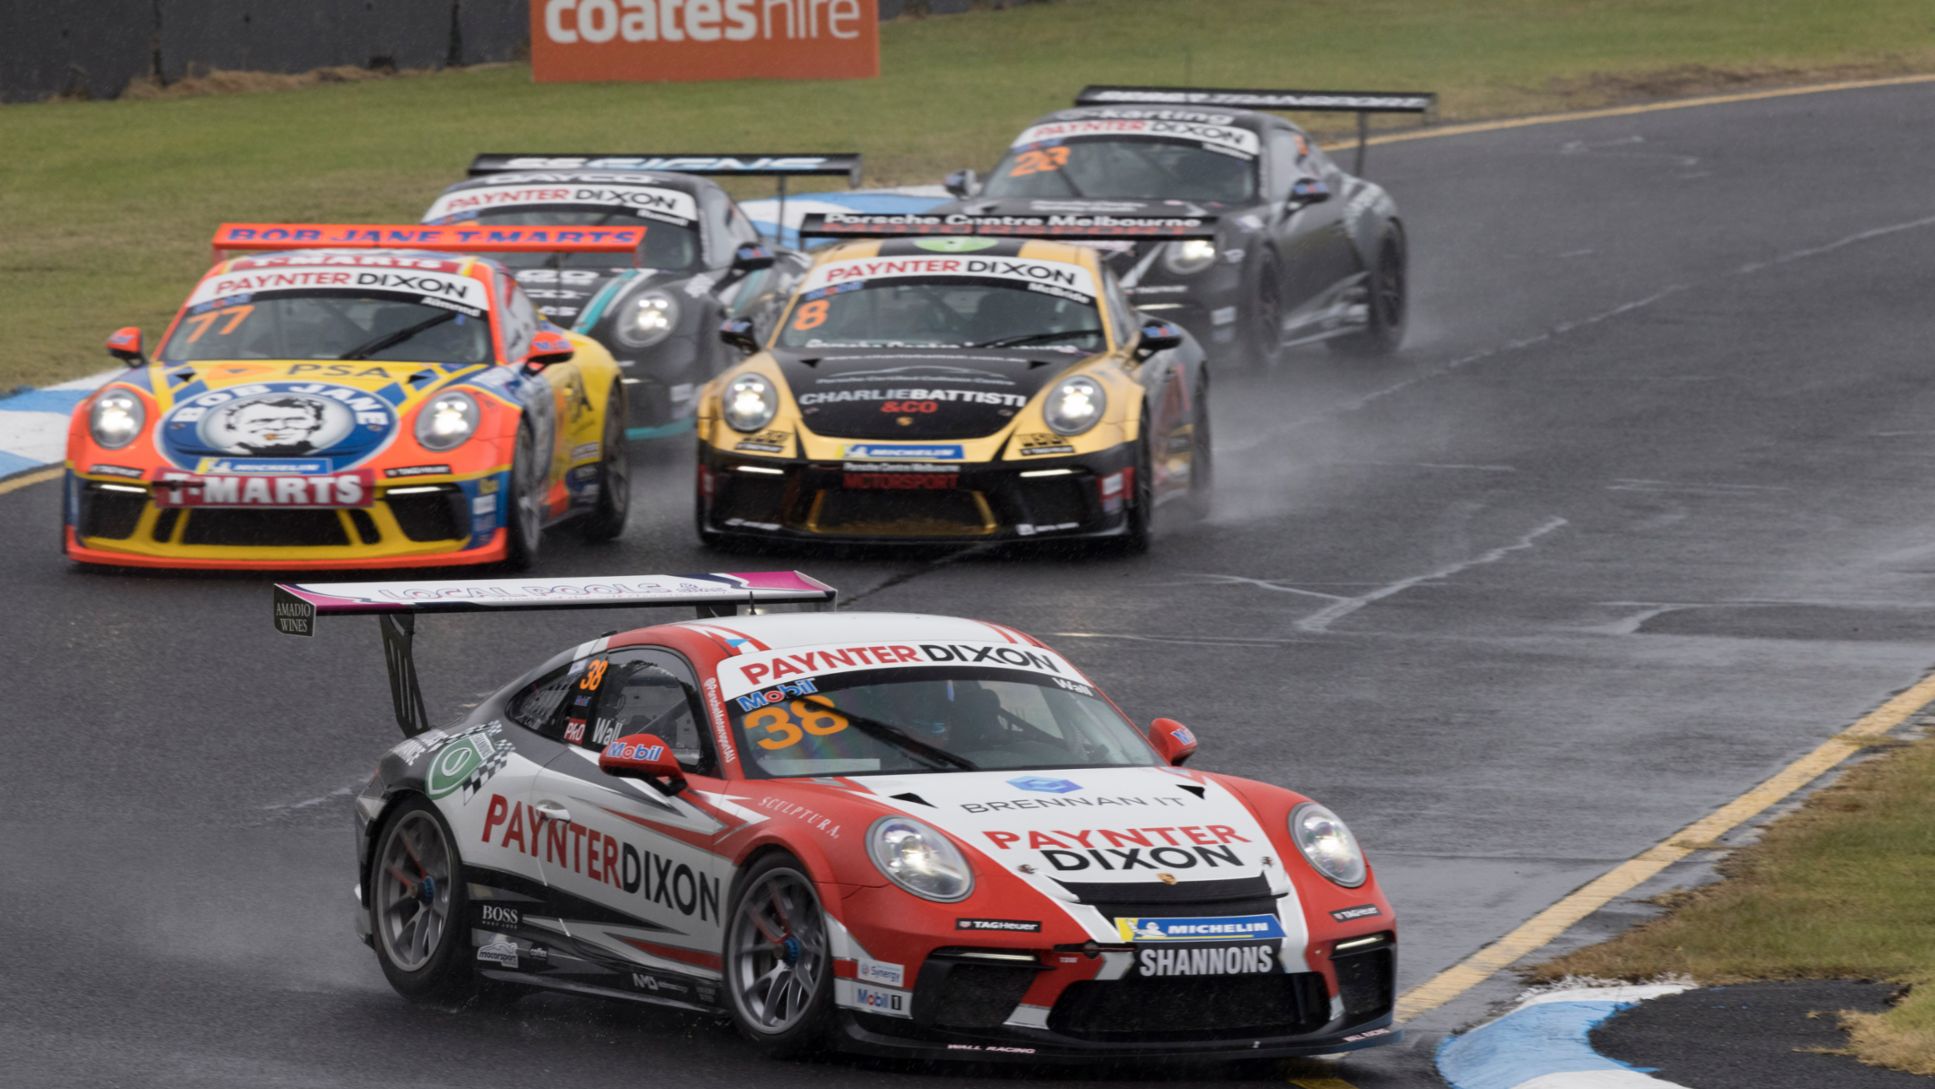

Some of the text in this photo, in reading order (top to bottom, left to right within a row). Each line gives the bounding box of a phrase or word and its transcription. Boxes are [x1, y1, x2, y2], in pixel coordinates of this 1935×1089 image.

[448, 189, 677, 212] PAYNTER DIXON
[823, 213, 941, 227] Porsche
[1047, 216, 1202, 227] Melbourne
[228, 227, 323, 243] BOB
[330, 228, 440, 243] JANE
[826, 259, 1077, 286] PAYNTER DIXON
[215, 271, 469, 299] PAYNTER DIXON
[186, 304, 256, 345] 77
[792, 300, 831, 331] 8
[286, 363, 391, 379] PSA
[170, 381, 390, 427] BOB JANE
[880, 400, 940, 414] &CO
[276, 602, 311, 617] AMADIO
[280, 618, 308, 633] WINES
[580, 659, 609, 691] 38
[737, 677, 819, 714] Mobil
[1055, 676, 1095, 698] Wall
[592, 717, 624, 746] Wall
[744, 694, 850, 752] 38
[606, 740, 665, 762] Mobil
[960, 796, 1188, 814] BRENNAN IT
[982, 824, 1254, 850] PAYNTER
[1040, 844, 1245, 871] DIXON
[482, 905, 519, 925] BOSS
[1167, 921, 1270, 935] MICHELIN
[1139, 945, 1274, 977] SHANNONS
[857, 988, 902, 1011] Mobil 1
